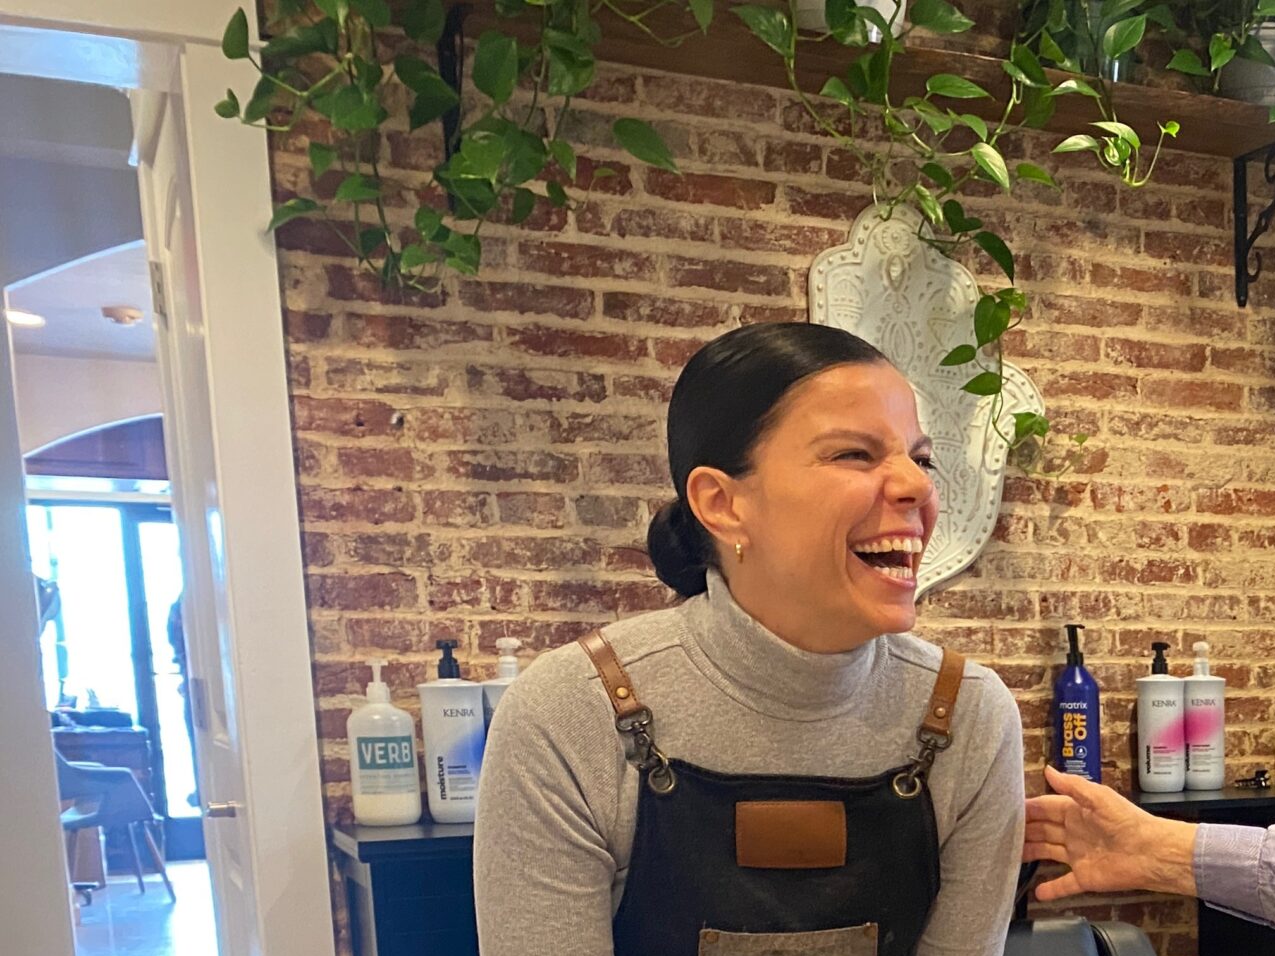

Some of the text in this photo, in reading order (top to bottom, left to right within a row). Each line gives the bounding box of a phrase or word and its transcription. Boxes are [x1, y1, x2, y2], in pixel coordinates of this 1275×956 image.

[1059, 701, 1087, 709] matrix
[1152, 700, 1176, 708] KENRA
[1192, 699, 1216, 707] KENRA
[443, 708, 475, 717] KENRA
[1074, 713, 1087, 740] Off
[1063, 713, 1074, 756] Brass
[361, 742, 412, 764] VERB
[437, 756, 447, 800] moisture
